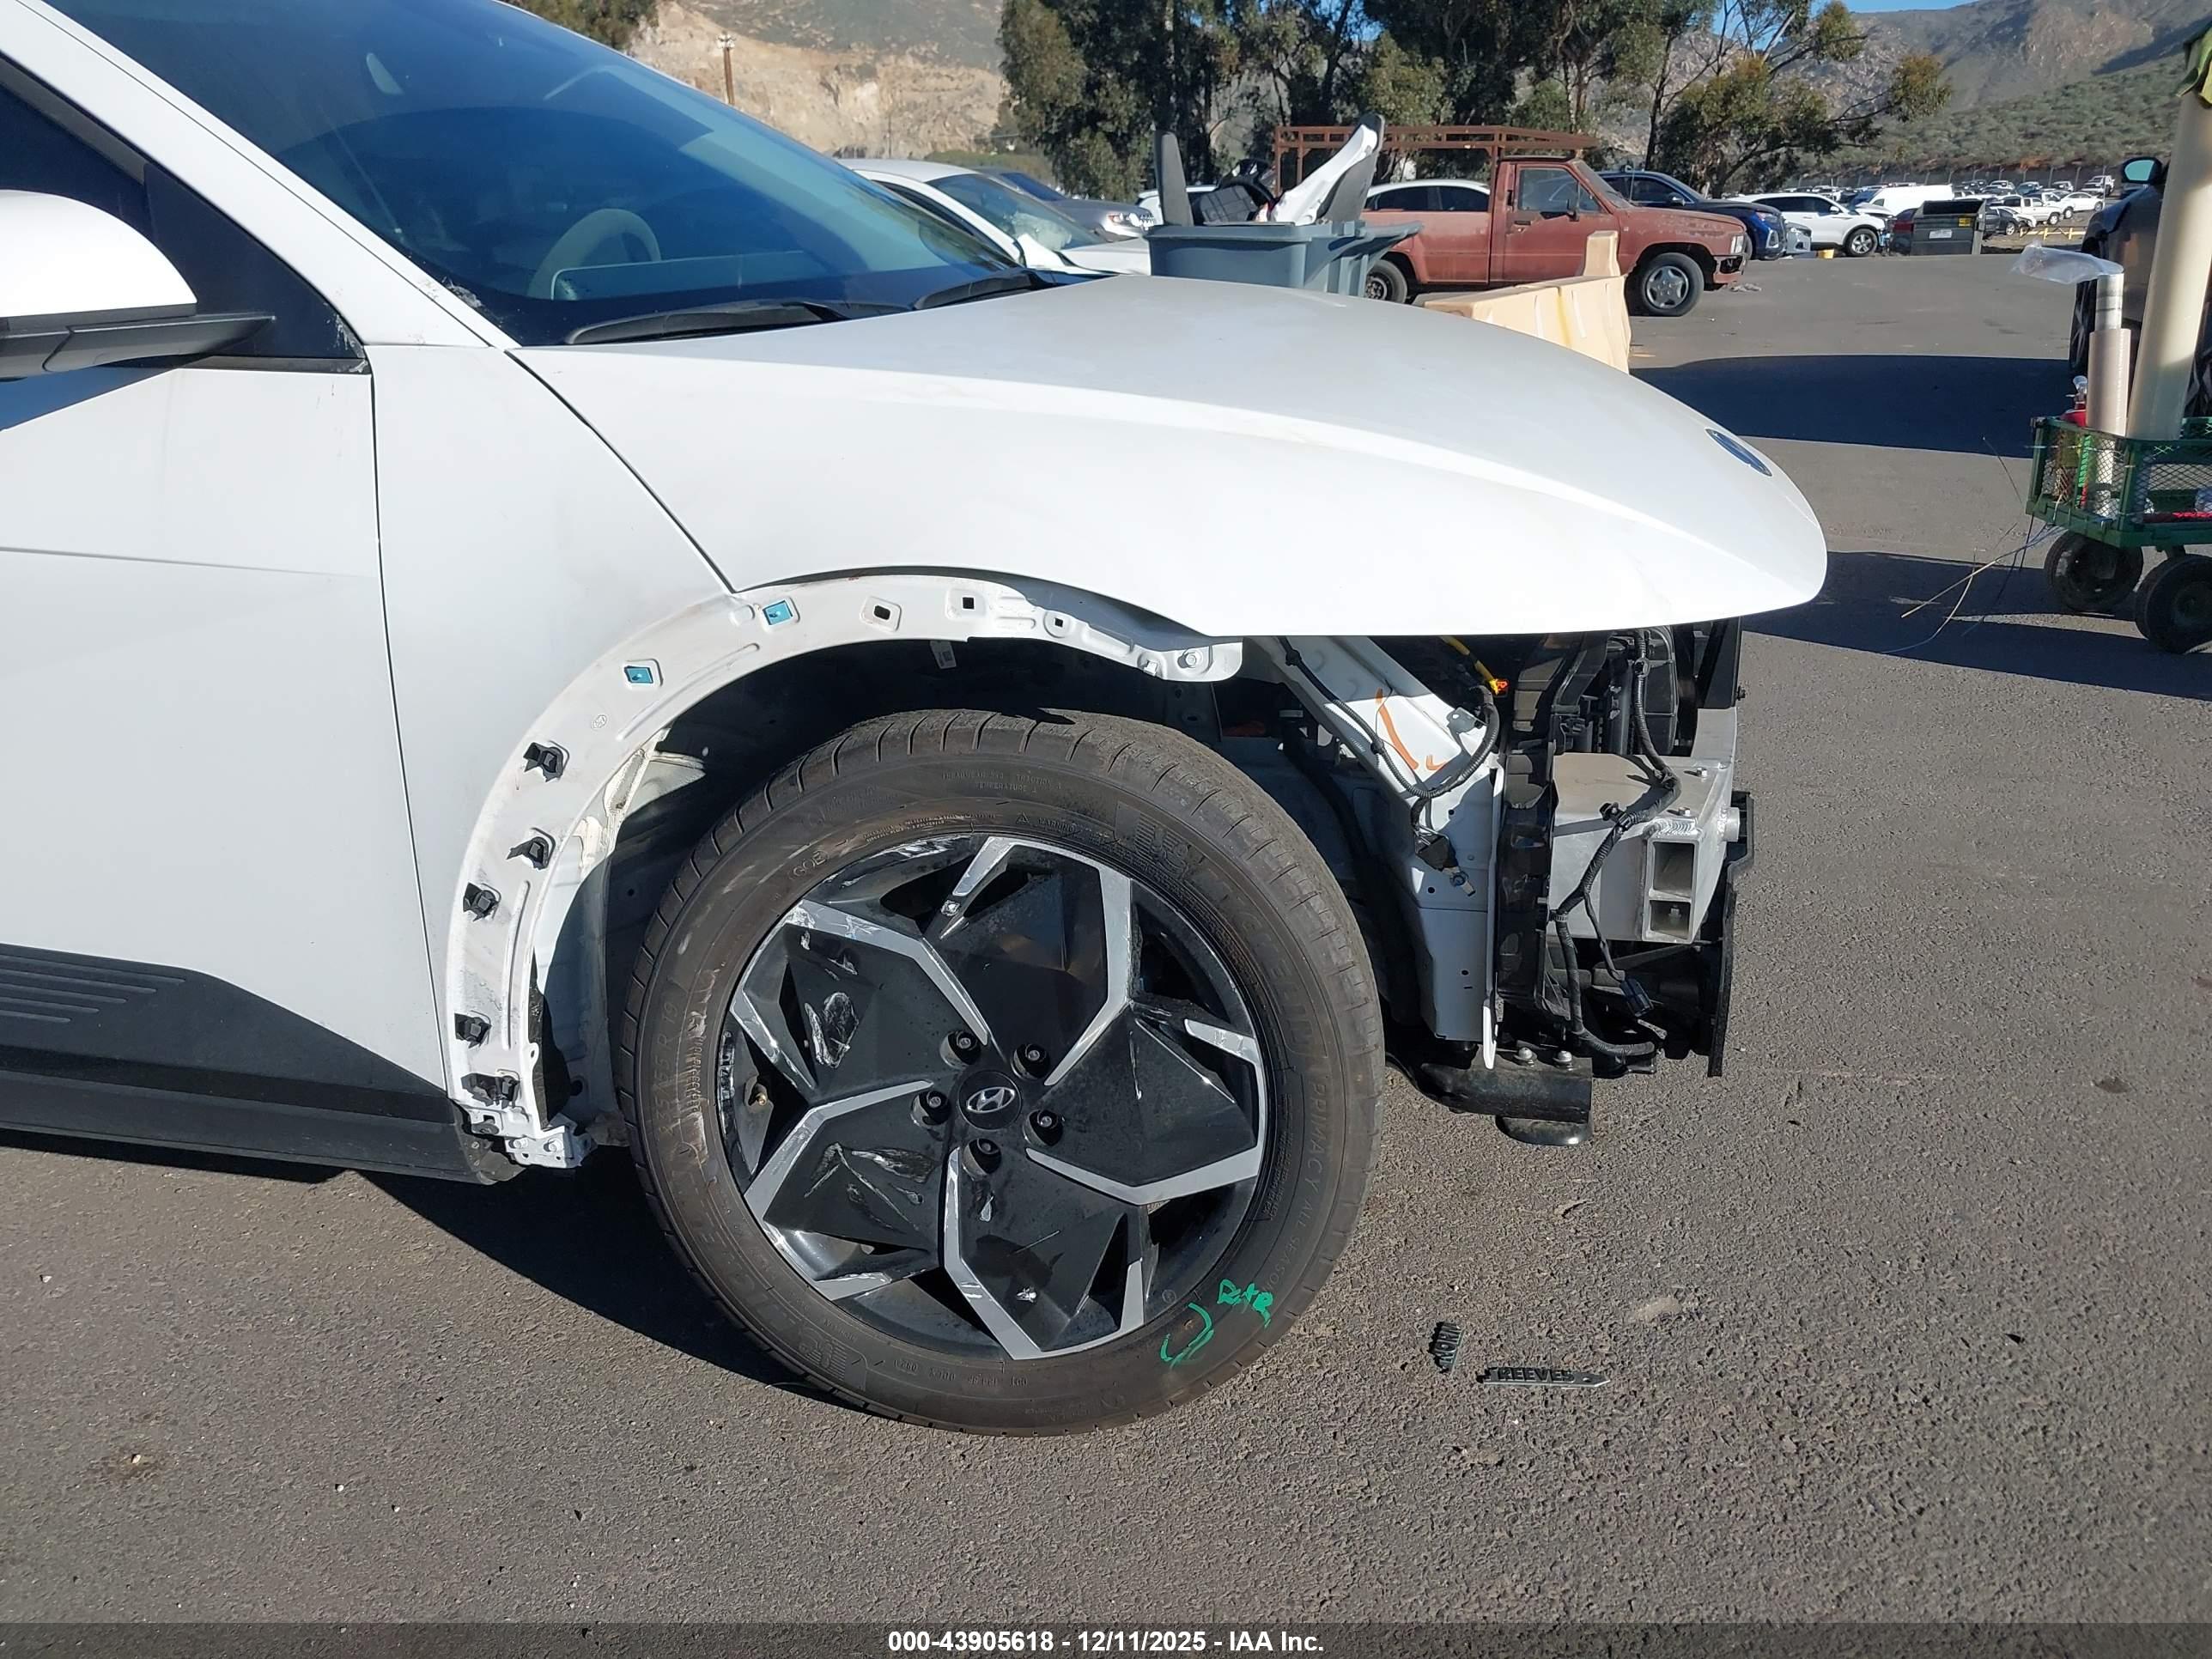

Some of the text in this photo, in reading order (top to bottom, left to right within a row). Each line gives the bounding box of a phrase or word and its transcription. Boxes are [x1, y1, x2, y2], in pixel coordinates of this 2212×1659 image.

[660, 1001, 679, 1024] 19
[1302, 1080, 1327, 1194] PRIMACY
[1293, 1196, 1315, 1231] ALL
